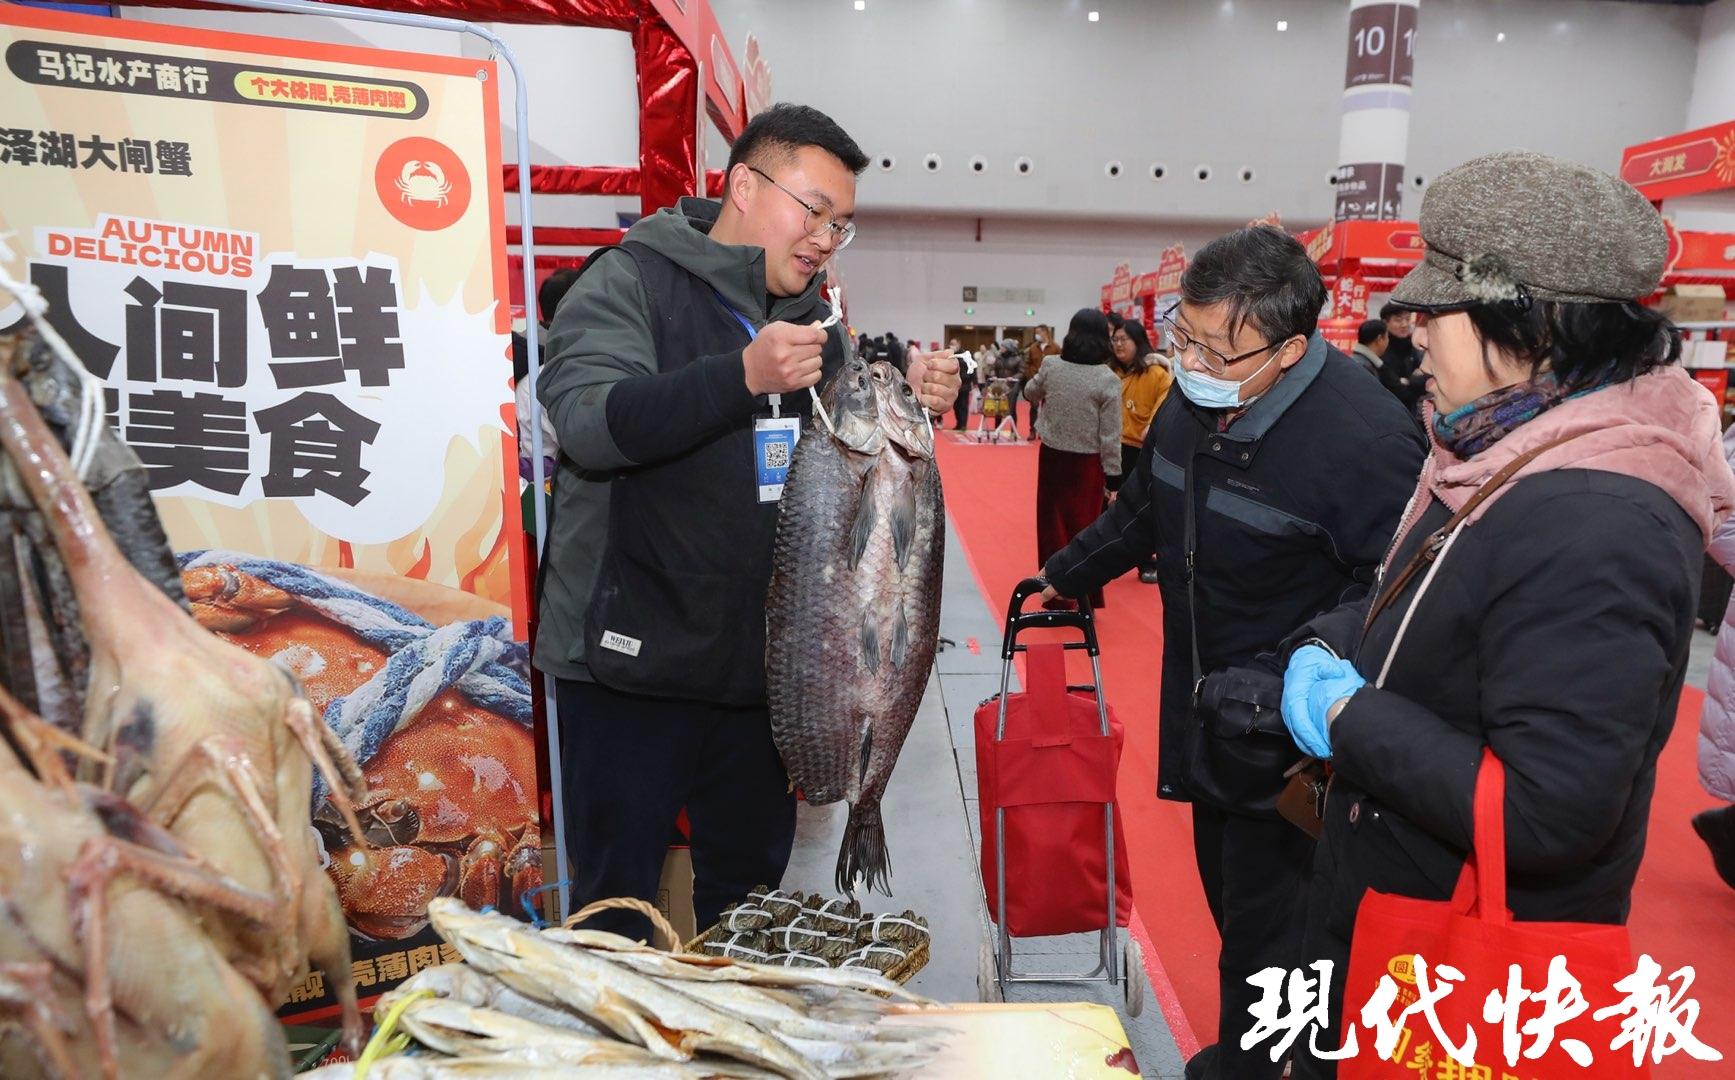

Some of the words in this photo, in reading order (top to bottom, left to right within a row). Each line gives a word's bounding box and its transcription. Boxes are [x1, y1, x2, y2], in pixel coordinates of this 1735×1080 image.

[1355, 26, 1385, 57] 10
[36, 49, 209, 94] 马记水产商行
[0, 127, 193, 177] 泽湖大闸蟹
[48, 233, 252, 277] DELICIOUS
[102, 218, 252, 256] AUTUMN
[103, 387, 381, 508] 美食
